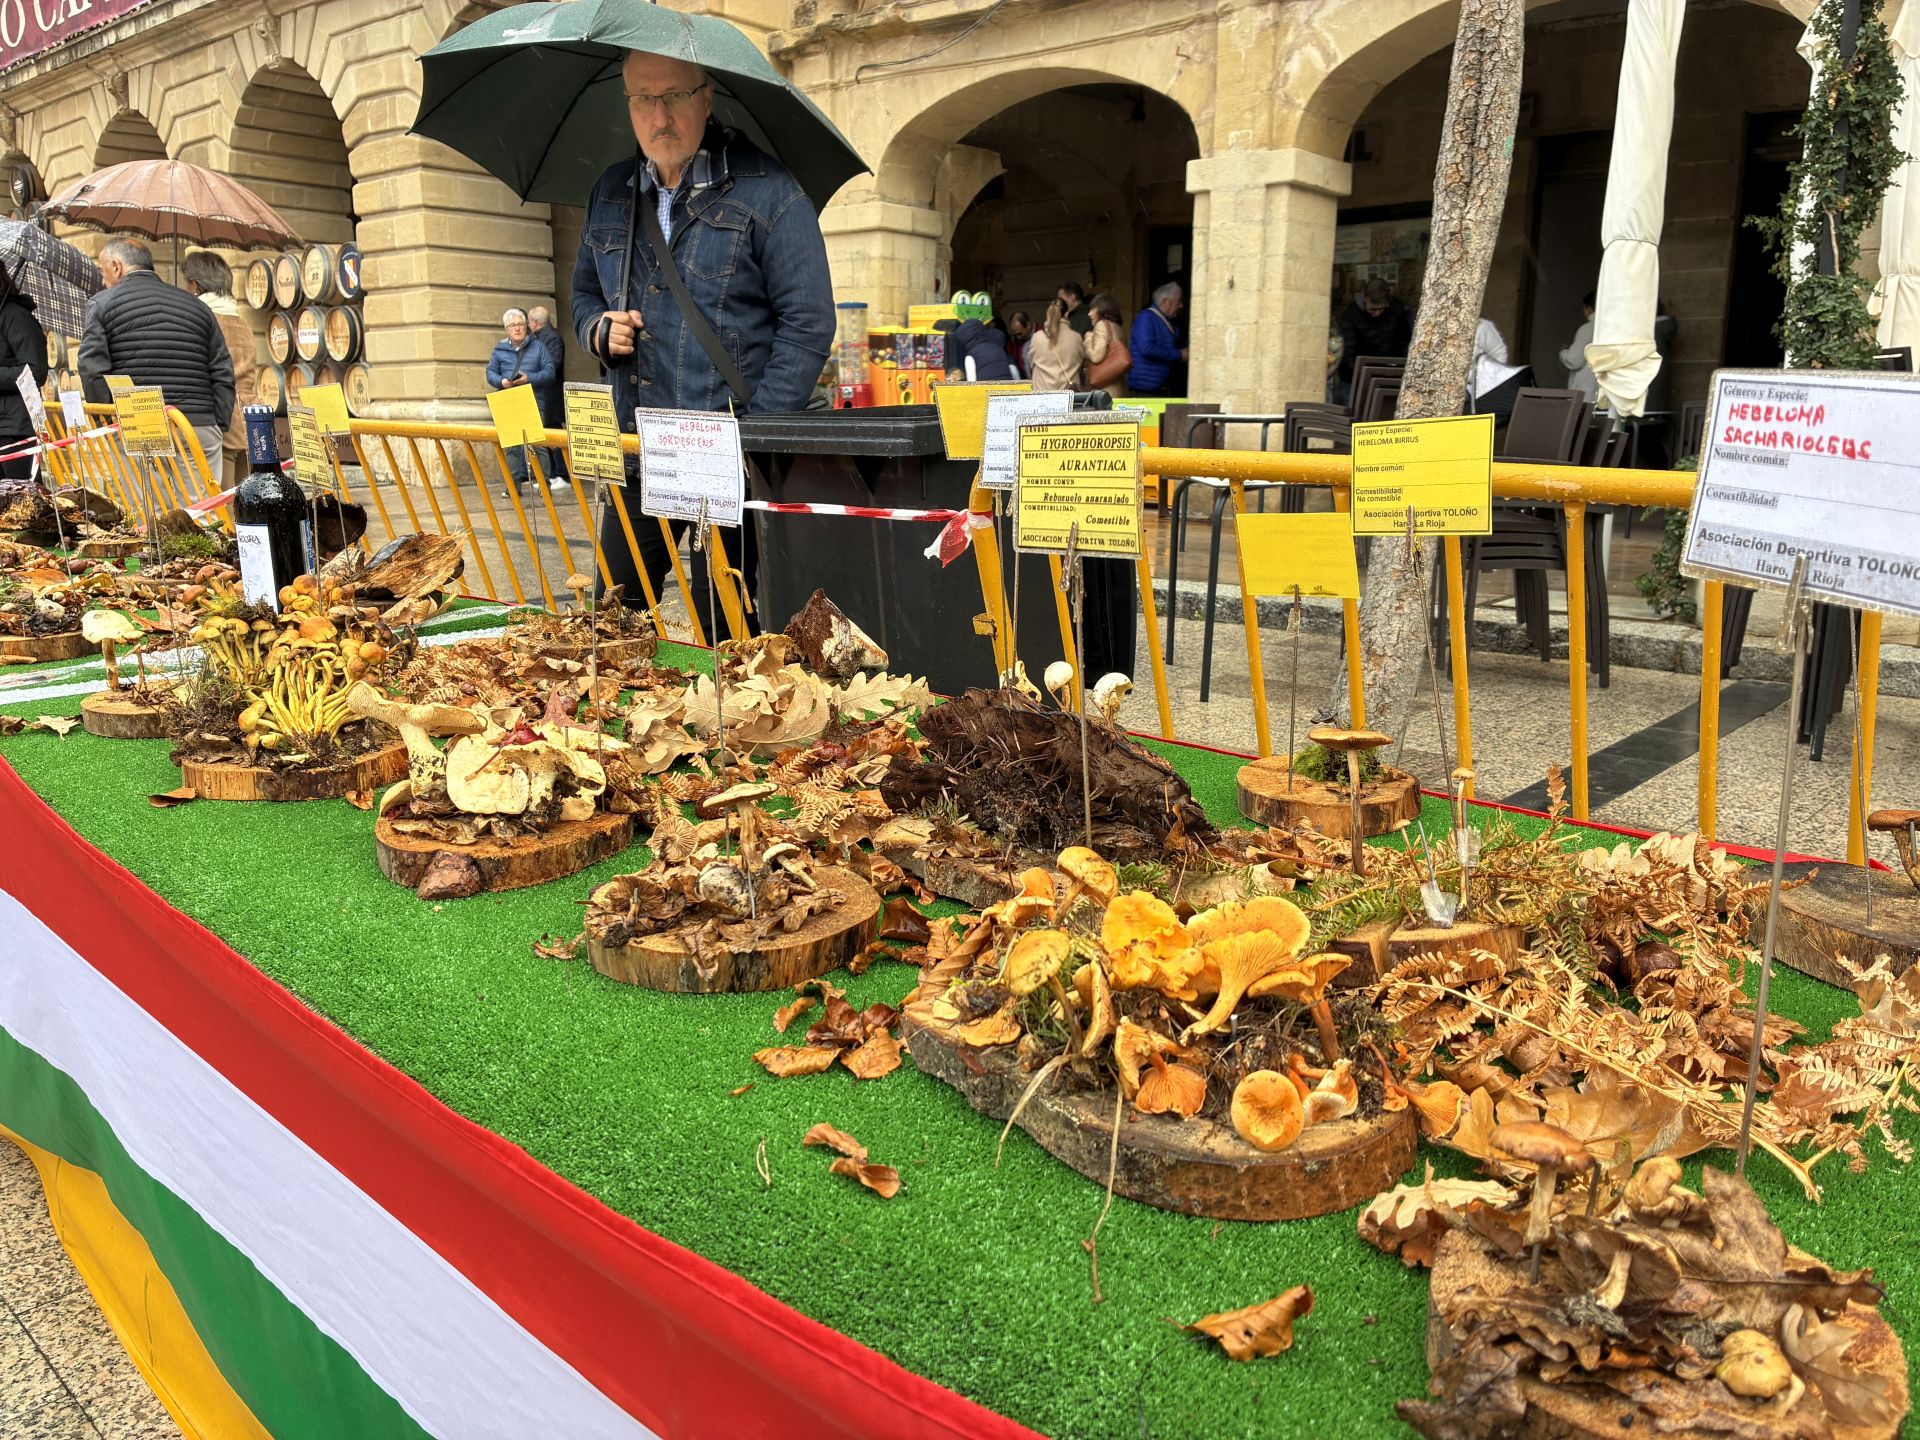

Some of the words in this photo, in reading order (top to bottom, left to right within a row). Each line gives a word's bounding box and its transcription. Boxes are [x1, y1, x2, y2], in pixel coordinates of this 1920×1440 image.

[1724, 384, 1757, 398] Género
[1759, 388, 1765, 399] y
[1767, 387, 1808, 402] Especie:
[1729, 402, 1825, 427] HEBELOMA
[680, 421, 722, 433] HEBELOMA
[1356, 428, 1379, 436] Género
[1386, 426, 1413, 434] Especie:
[1040, 436, 1132, 450] HYGROPHOROPSIS
[1358, 438, 1394, 446] HEBELOMA
[1395, 436, 1419, 444] BIRRUS
[1713, 448, 1750, 463] Nombre
[1752, 453, 1789, 468] común:
[1059, 459, 1127, 471] AURANTIACA
[1355, 487, 1404, 495] Comestibilidad:
[1705, 487, 1779, 507] Comestibilidad:
[1043, 492, 1082, 502] Rebozuelo
[1085, 494, 1130, 505] anaranjado
[1367, 494, 1401, 502] comestible
[1364, 509, 1403, 518] Asociación
[1405, 508, 1441, 519] portiva
[1444, 506, 1478, 517] TOLOÑO
[1086, 514, 1130, 526] Comestible
[1426, 520, 1446, 529] Rioja
[1022, 534, 1063, 544] ASOCIACION
[1065, 536, 1105, 546] DPORTIVA
[1109, 537, 1135, 548] TOLOÑO
[1699, 527, 1772, 553] Asociación
[1755, 558, 1789, 579] Haro,
[1812, 570, 1845, 588] Rioja
